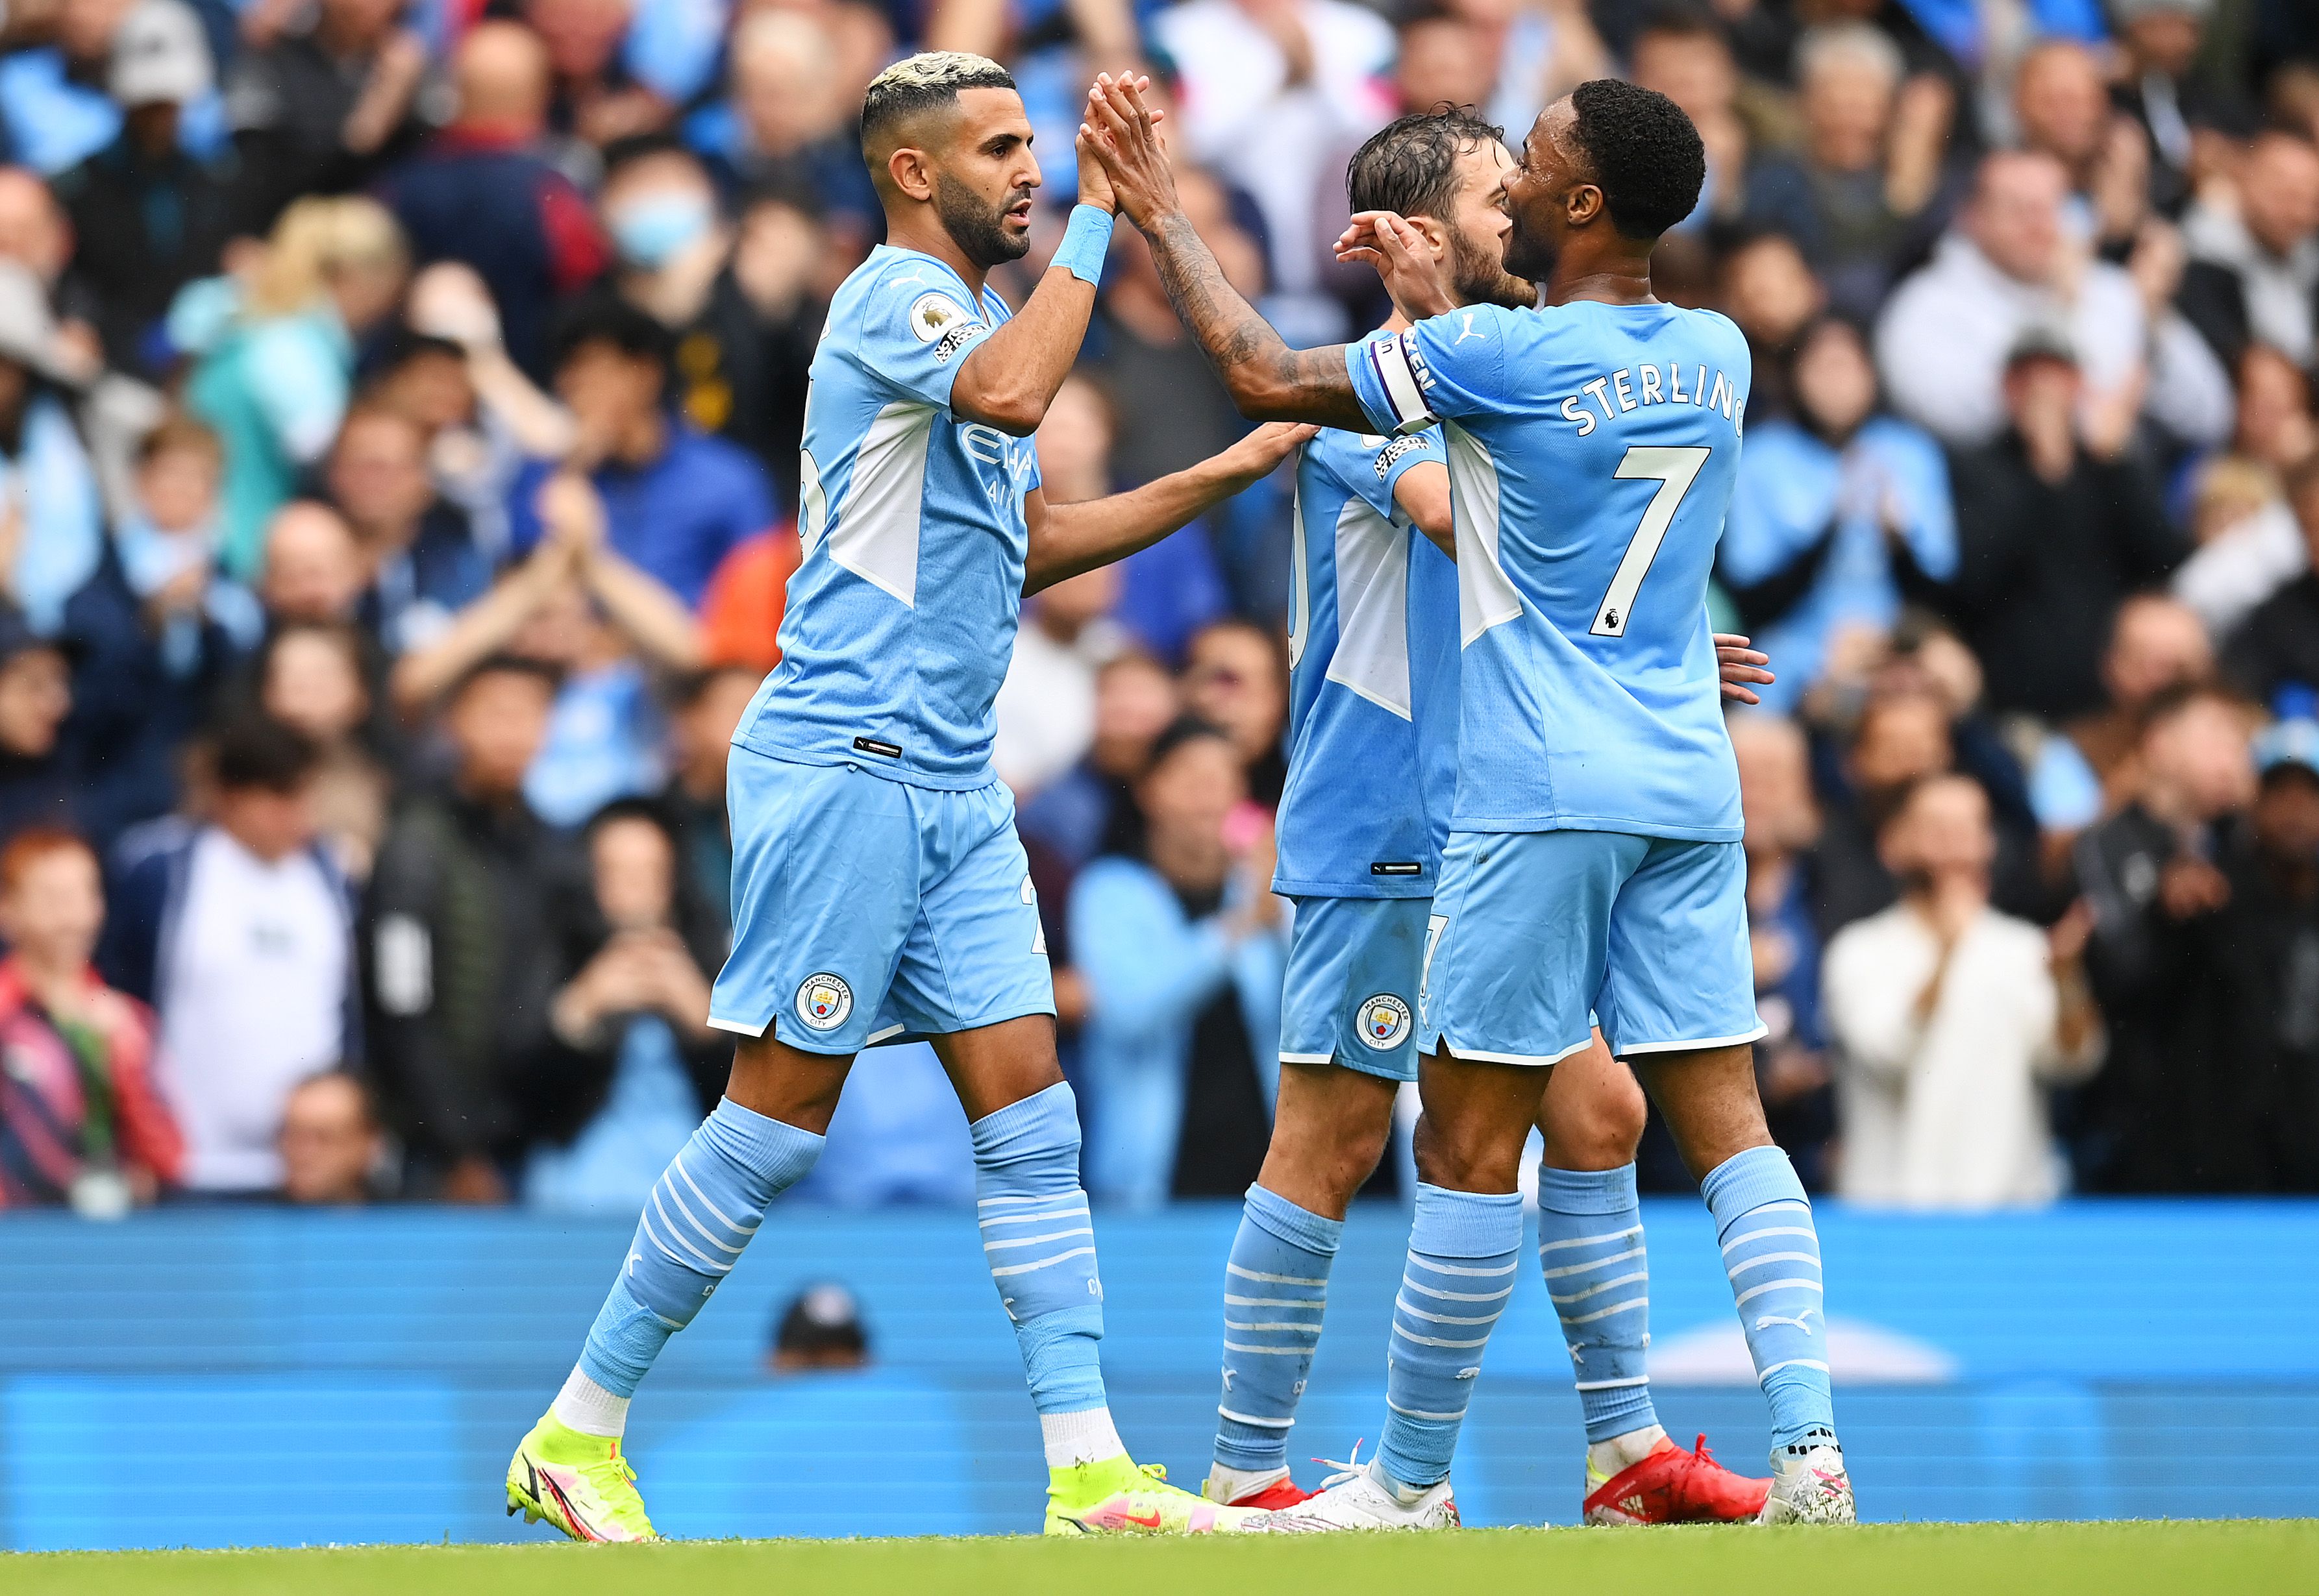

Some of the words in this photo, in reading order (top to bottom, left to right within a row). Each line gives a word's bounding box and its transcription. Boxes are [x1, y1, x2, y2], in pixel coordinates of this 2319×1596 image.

[933, 339, 950, 359] No
[937, 345, 954, 365] for
[1373, 454, 1386, 474] No
[1385, 437, 1421, 456] room
[1588, 447, 1712, 637] 7
[1419, 914, 1450, 998] 7
[804, 976, 849, 1000] MANCHESTER
[1365, 997, 1409, 1020] MANCHESTER
[810, 1018, 826, 1027] CITY
[1369, 1038, 1386, 1048] CITY
